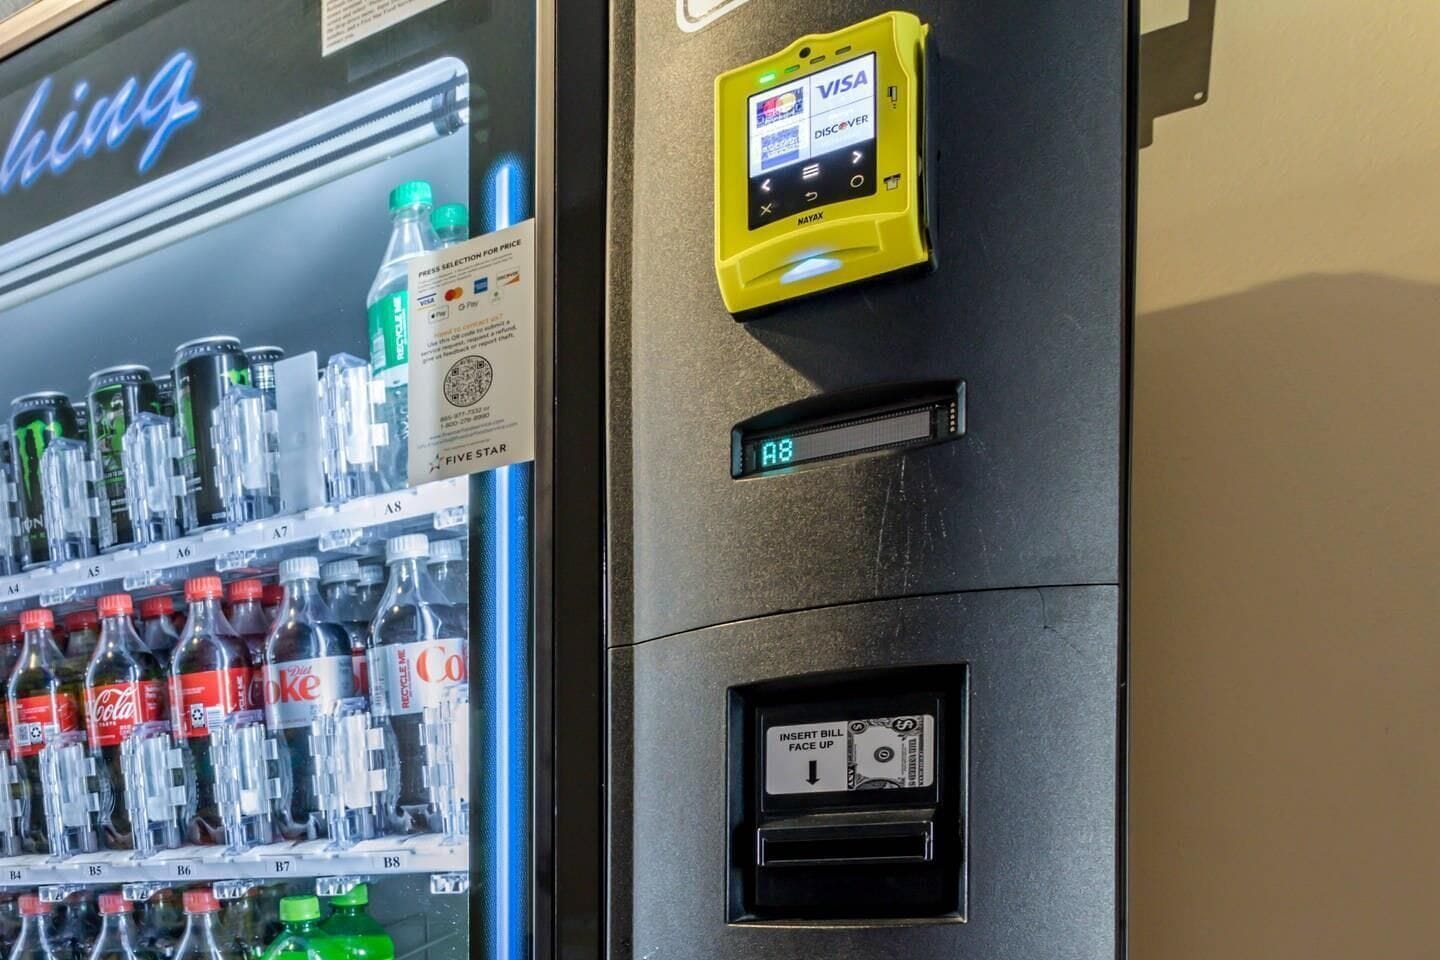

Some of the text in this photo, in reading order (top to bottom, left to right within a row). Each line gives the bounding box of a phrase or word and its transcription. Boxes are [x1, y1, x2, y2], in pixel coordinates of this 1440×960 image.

[816, 70, 868, 99] VISA
[814, 114, 868, 139] DISCOVER
[798, 212, 824, 226] NAYAX
[418, 265, 440, 278] PRESS
[442, 251, 481, 270] SELECTION
[484, 246, 498, 257] FOR
[500, 238, 521, 251] PRICE
[446, 451, 472, 465] FIVE
[476, 443, 506, 458] STAR
[763, 439, 793, 465] A8
[384, 501, 402, 515] A8
[272, 526, 288, 539] A7
[176, 548, 191, 559] A6
[88, 567, 100, 578] A5
[8, 584, 20, 595] A4
[398, 649, 410, 709] RECYCLE ME
[265, 670, 321, 704] oke
[779, 729, 844, 741] INSERT BILL
[789, 741, 834, 752] FACE UP
[275, 861, 290, 872] B7
[383, 856, 401, 869] B8
[10, 870, 21, 881] B4
[89, 866, 102, 877] B5
[177, 865, 191, 877] B6
